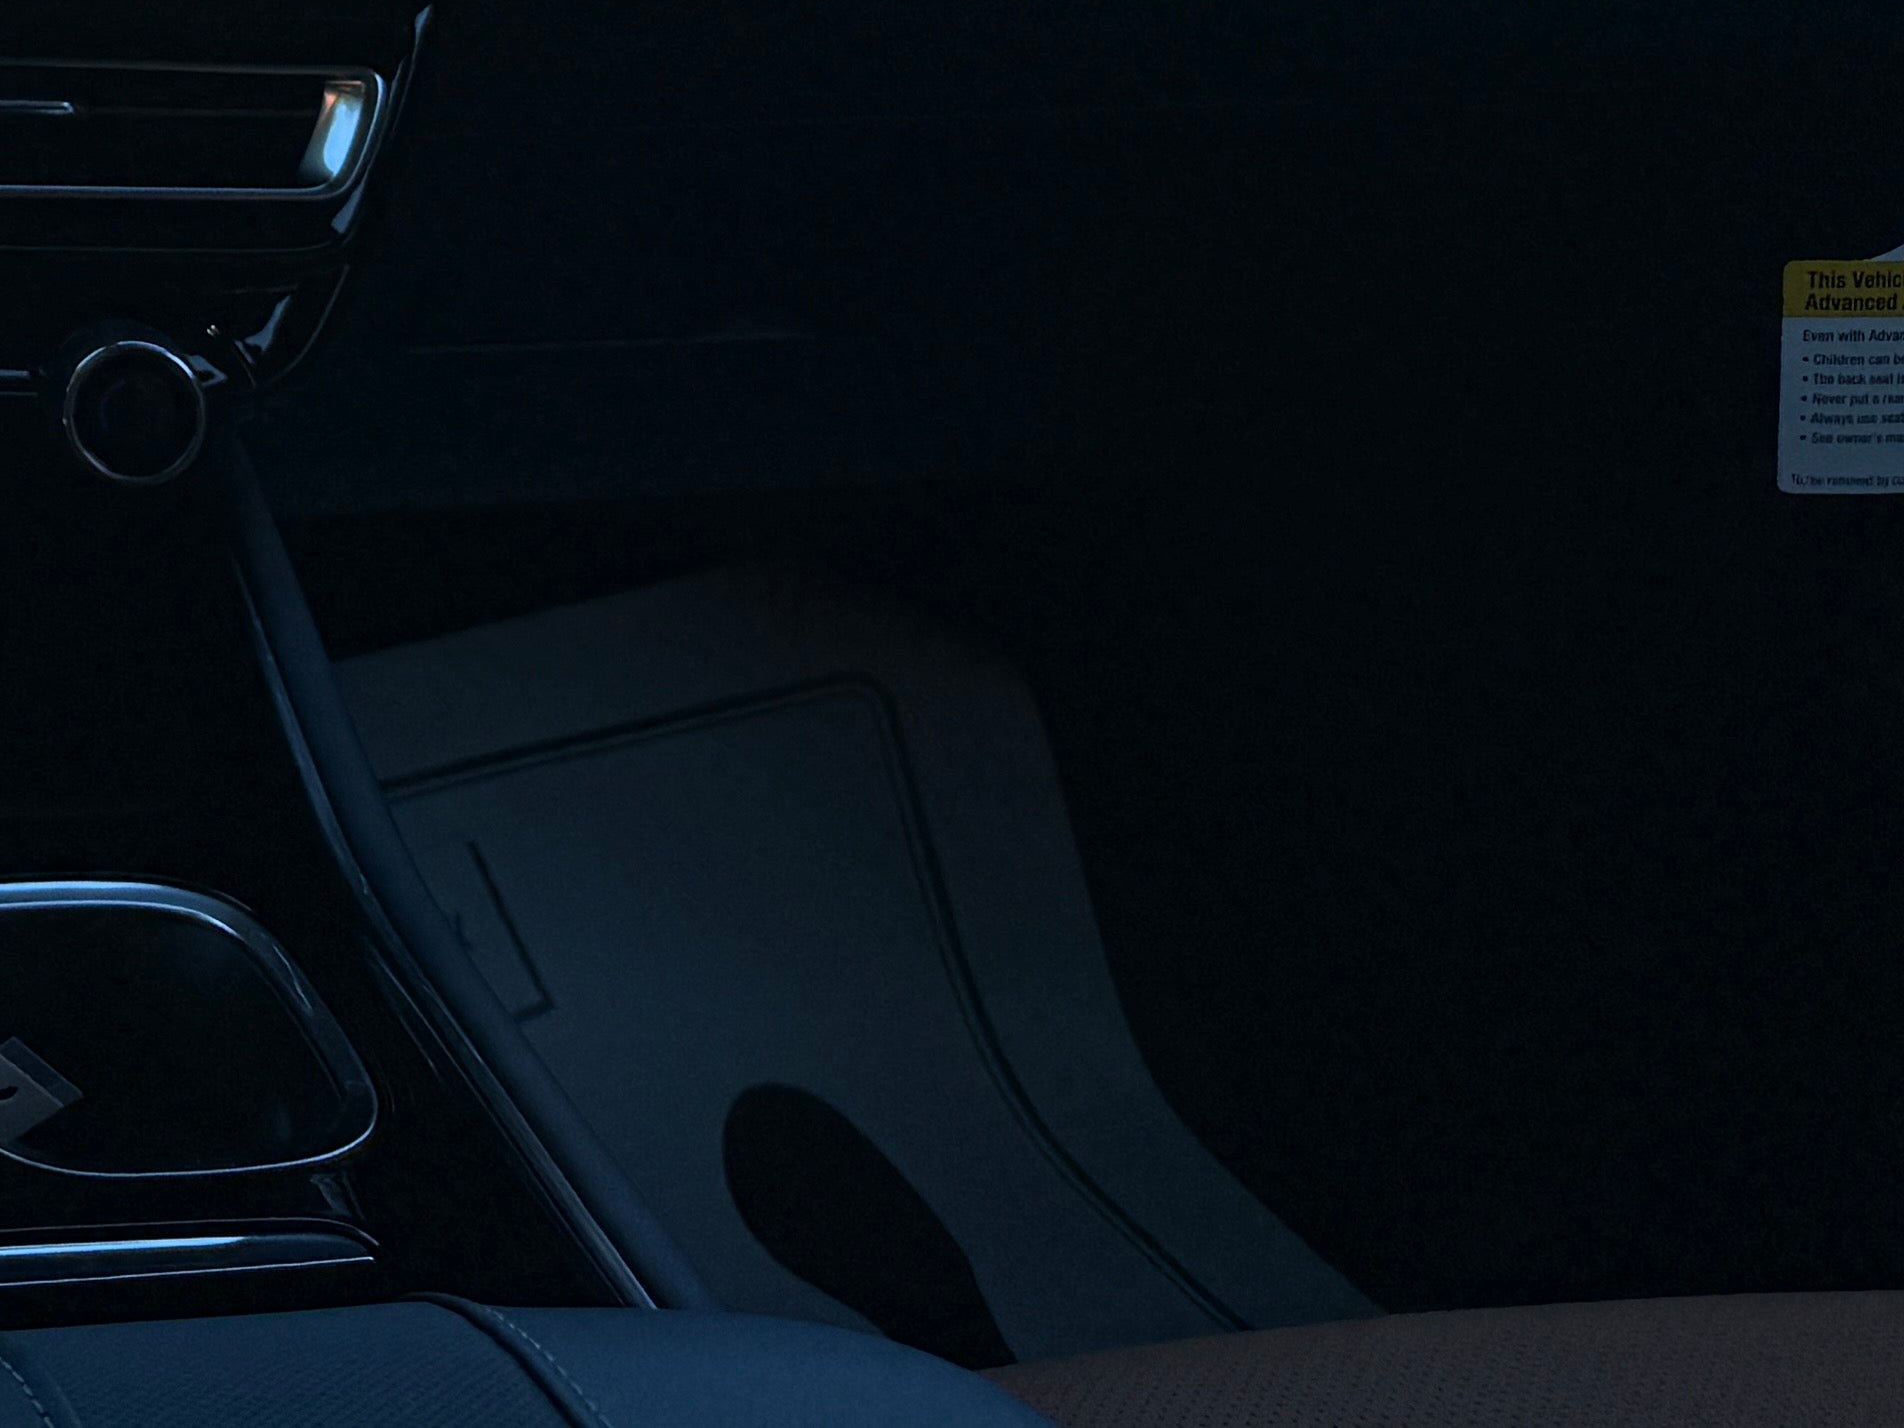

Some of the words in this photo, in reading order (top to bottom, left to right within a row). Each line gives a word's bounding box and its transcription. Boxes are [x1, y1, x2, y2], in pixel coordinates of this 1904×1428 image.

[1808, 271, 1846, 289] This
[1853, 271, 1904, 289] Vehic
[1805, 293, 1898, 311] Advanced
[1803, 329, 1834, 342] Even
[1838, 329, 1865, 342] with
[1813, 354, 1864, 366] Children
[1869, 357, 1890, 366] can
[1813, 373, 1835, 385] The
[1838, 373, 1865, 385] back
[1812, 393, 1847, 405] Never
[1810, 412, 1854, 426] Always
